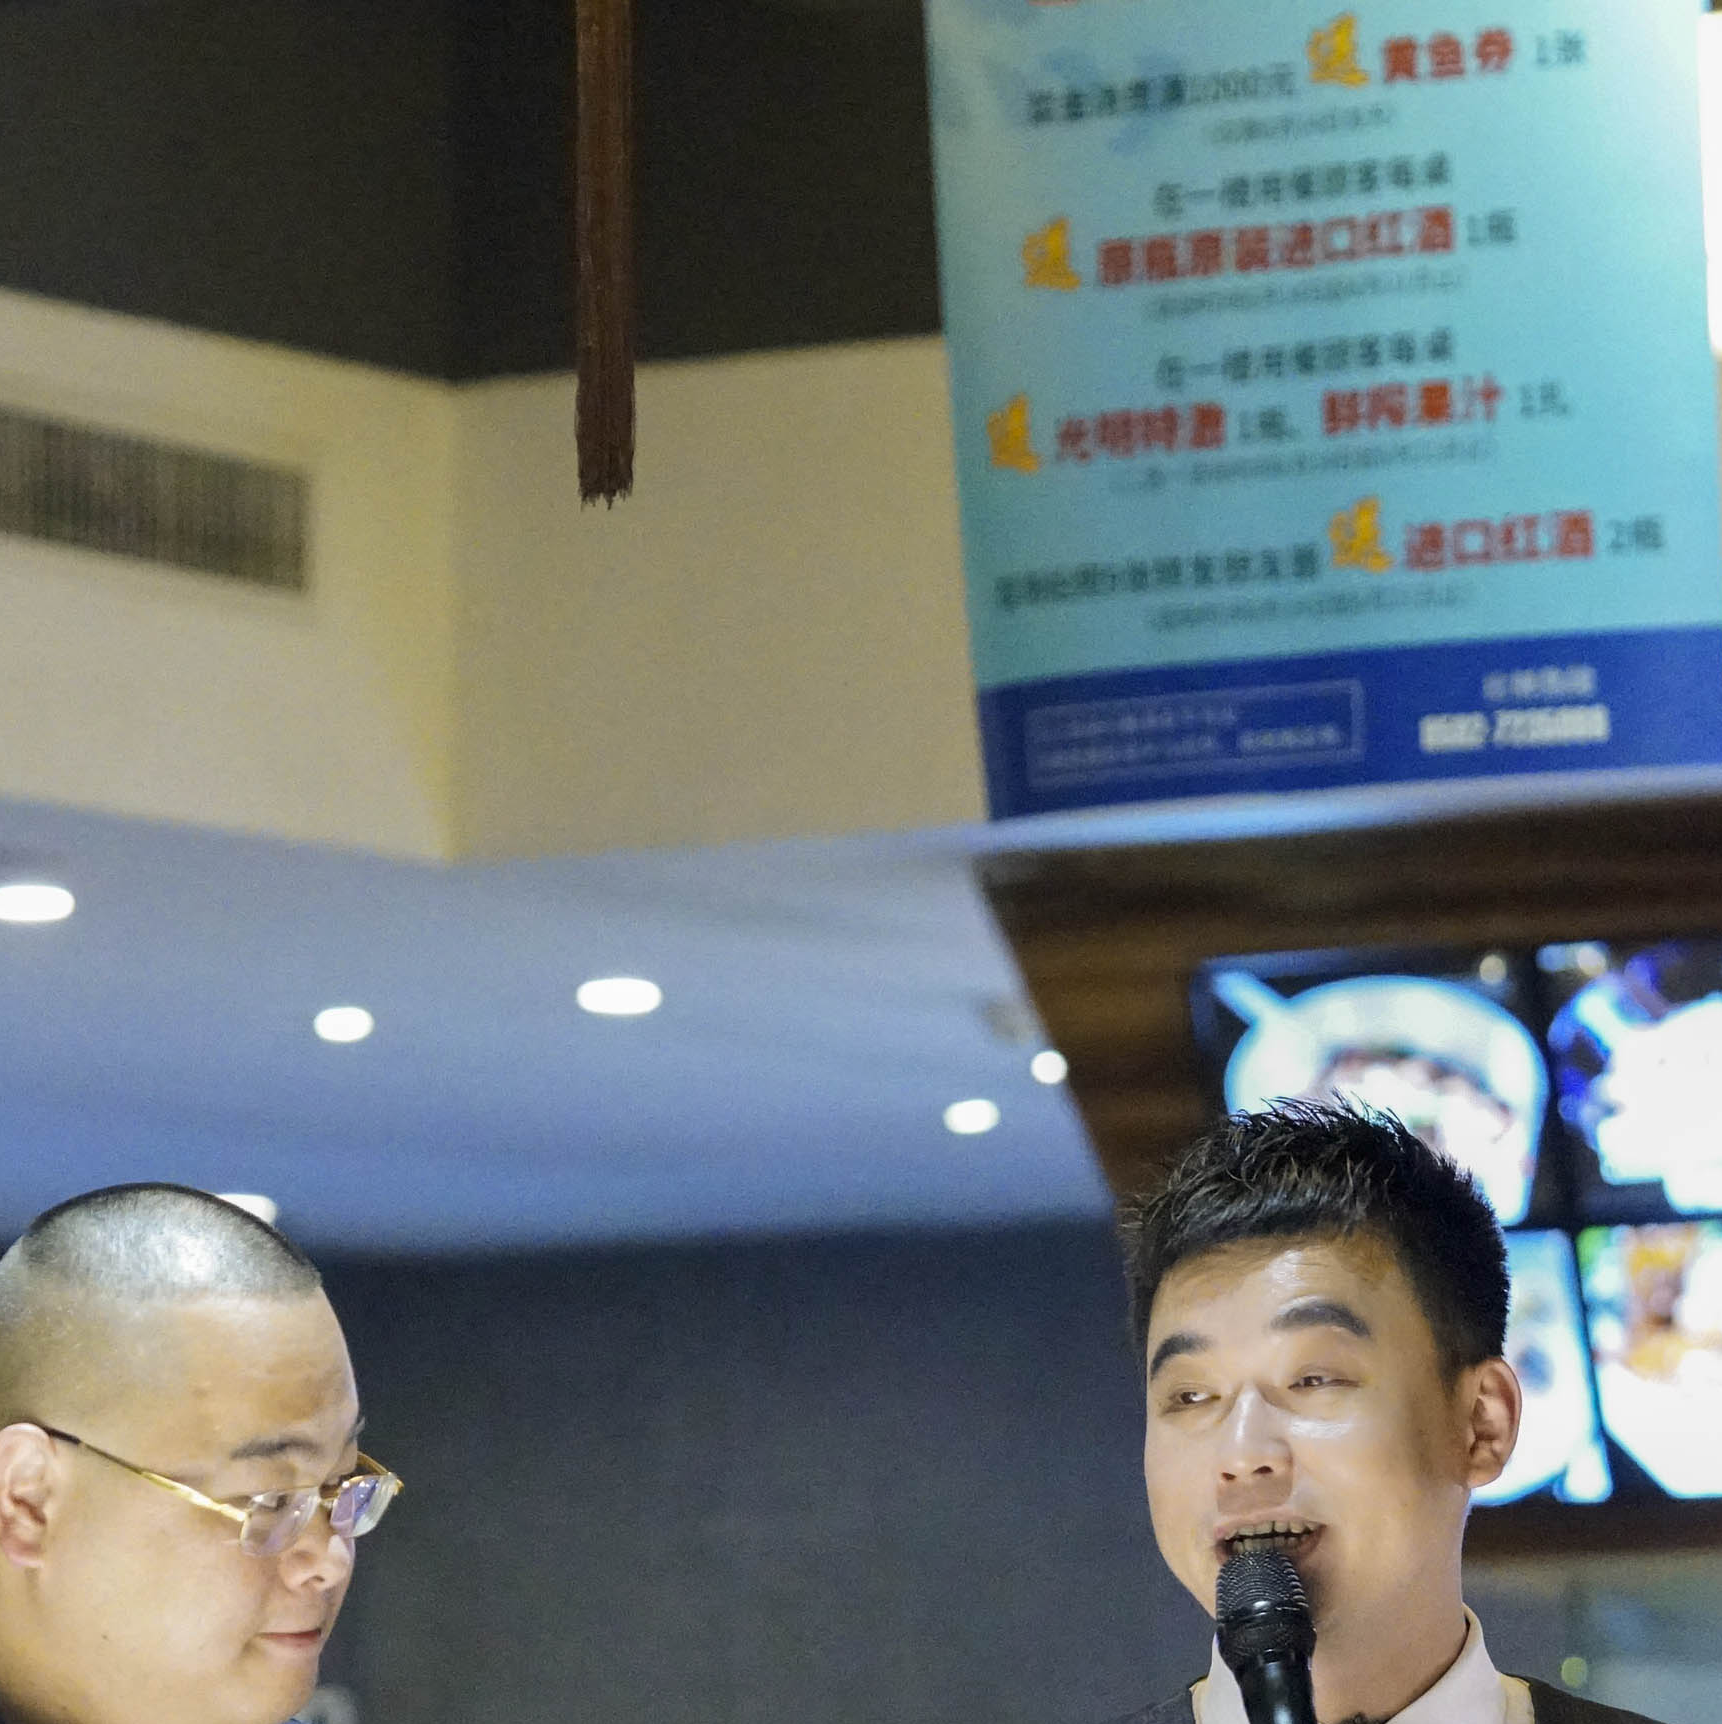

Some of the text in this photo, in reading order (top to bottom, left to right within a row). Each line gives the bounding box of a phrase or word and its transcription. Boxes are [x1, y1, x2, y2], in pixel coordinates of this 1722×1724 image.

[1383, 28, 1514, 83] 黄鱼券
[1404, 508, 1596, 572] 进口红酒
